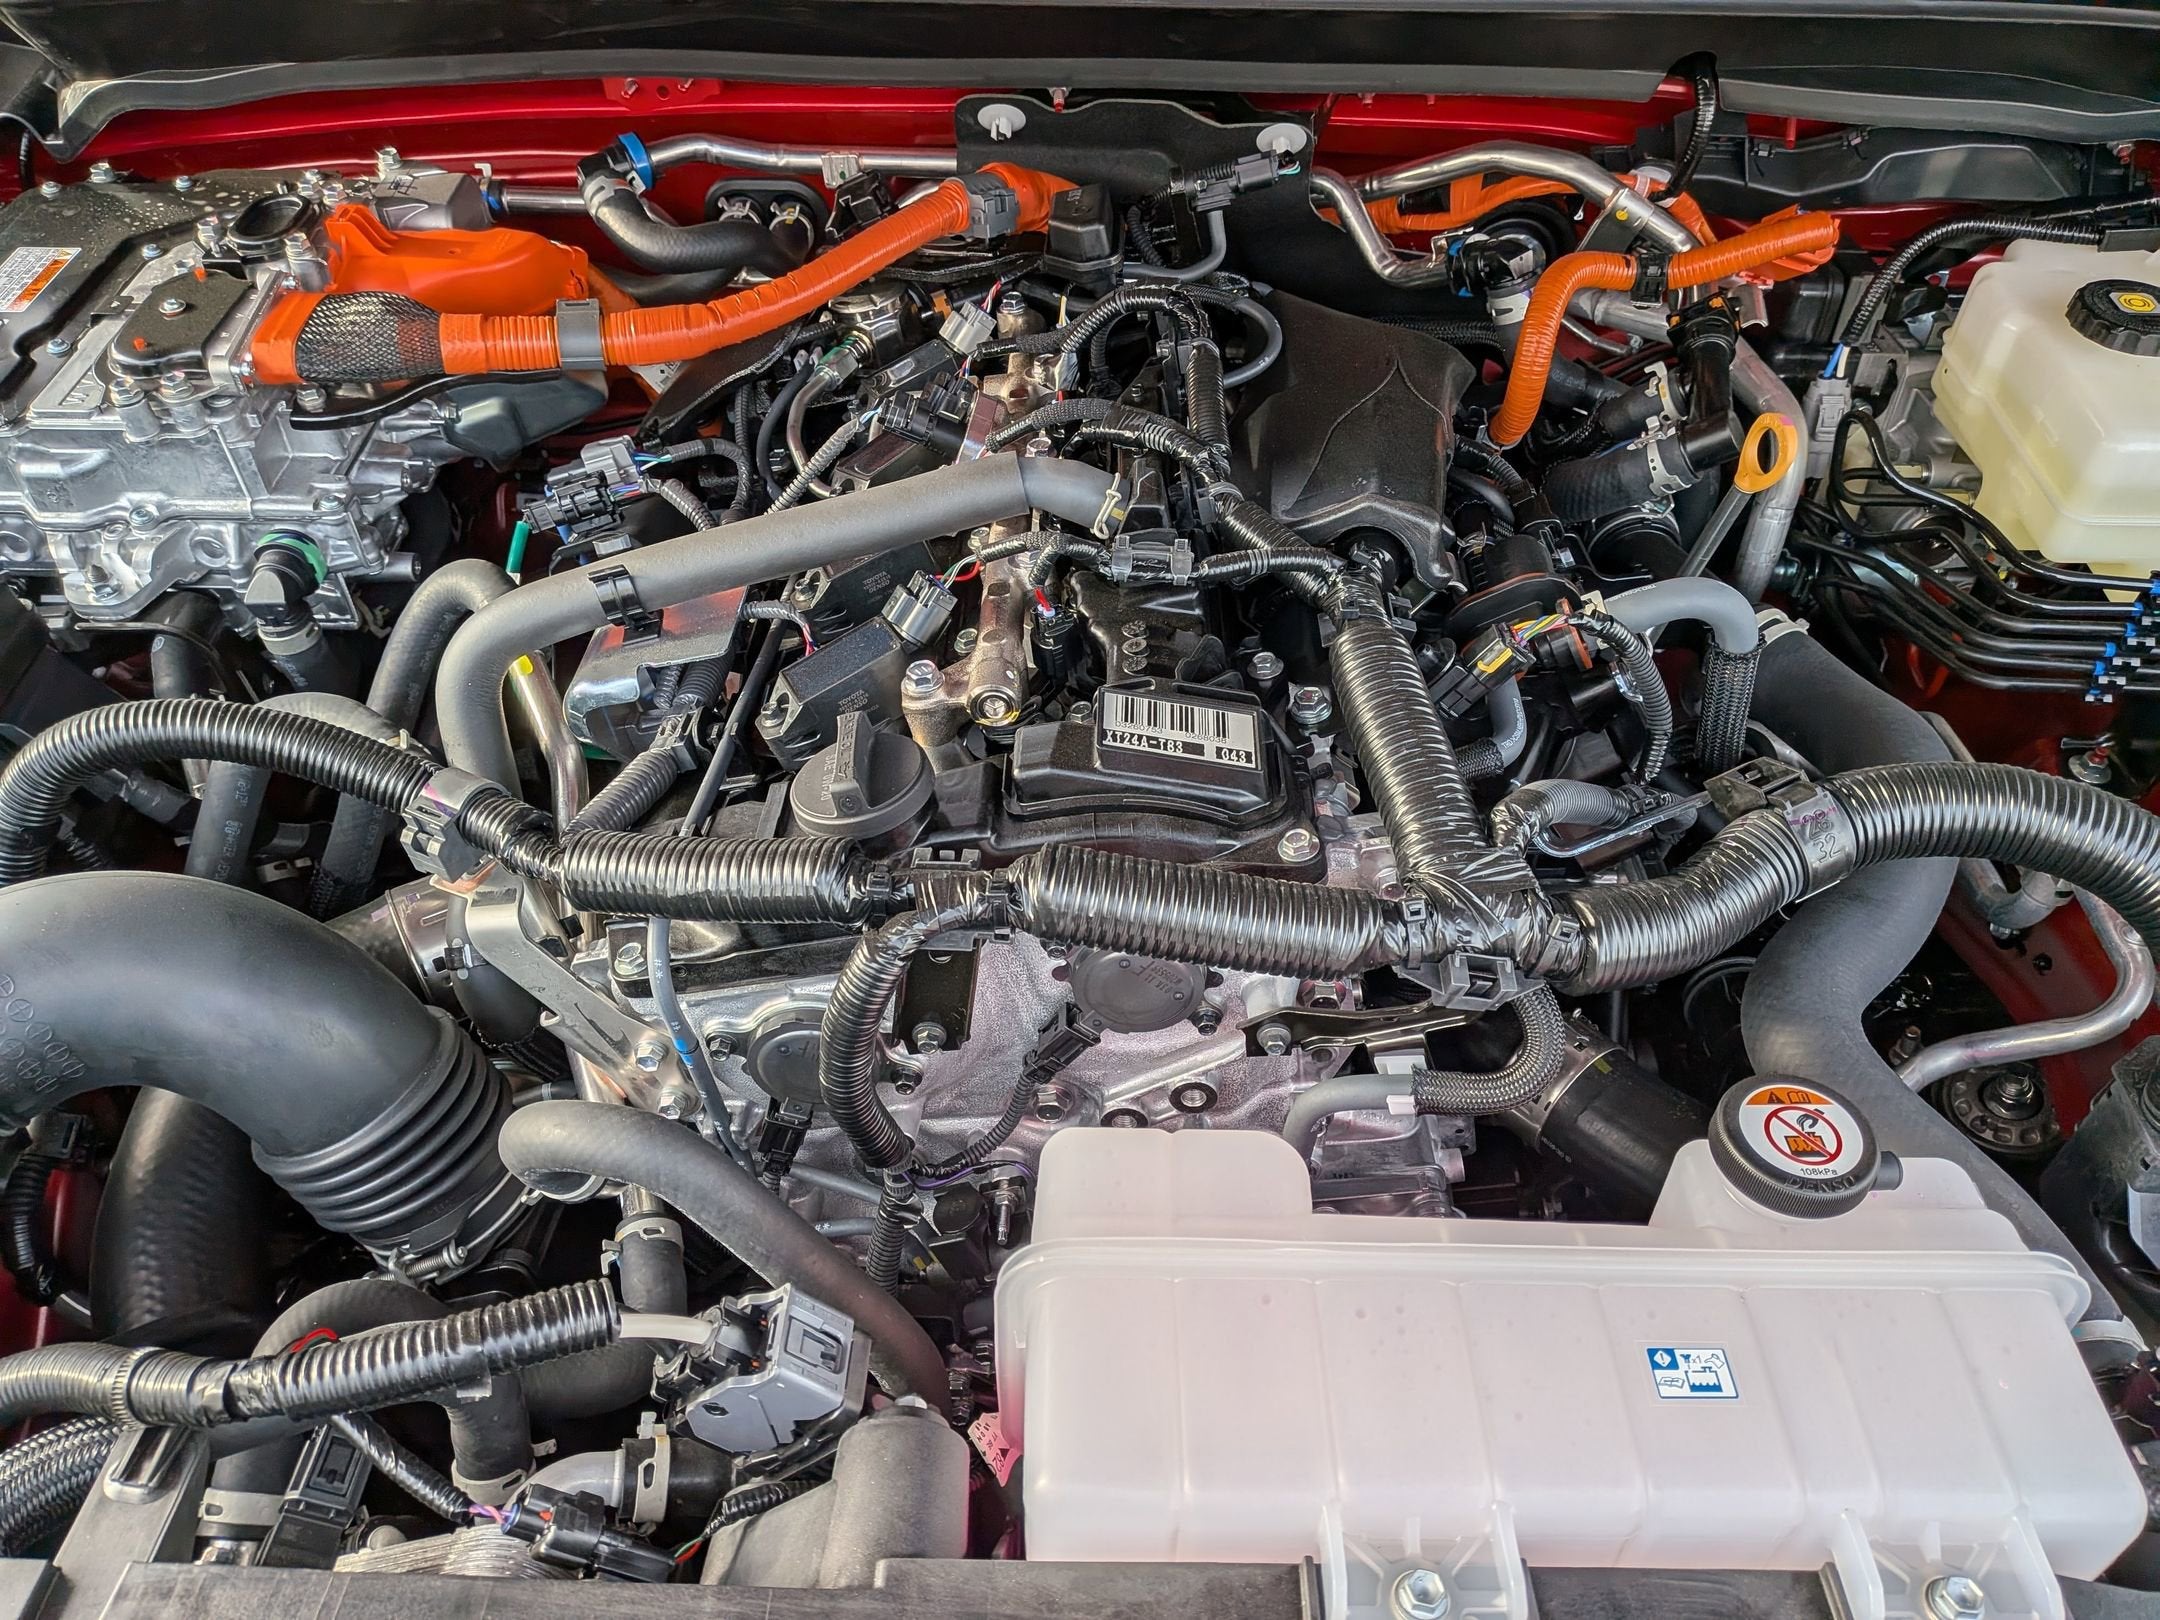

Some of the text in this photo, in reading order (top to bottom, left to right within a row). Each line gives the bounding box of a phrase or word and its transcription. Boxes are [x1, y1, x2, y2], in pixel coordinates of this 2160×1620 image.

[862, 571, 887, 585] TOYOTA
[869, 580, 890, 594] DENSO
[838, 690, 865, 706] TOYOTA
[845, 699, 868, 713] DENSO
[1221, 748, 1247, 764] 043
[1800, 1167, 1838, 1176] 108kPa
[1784, 1175, 1857, 1193] DENSO
